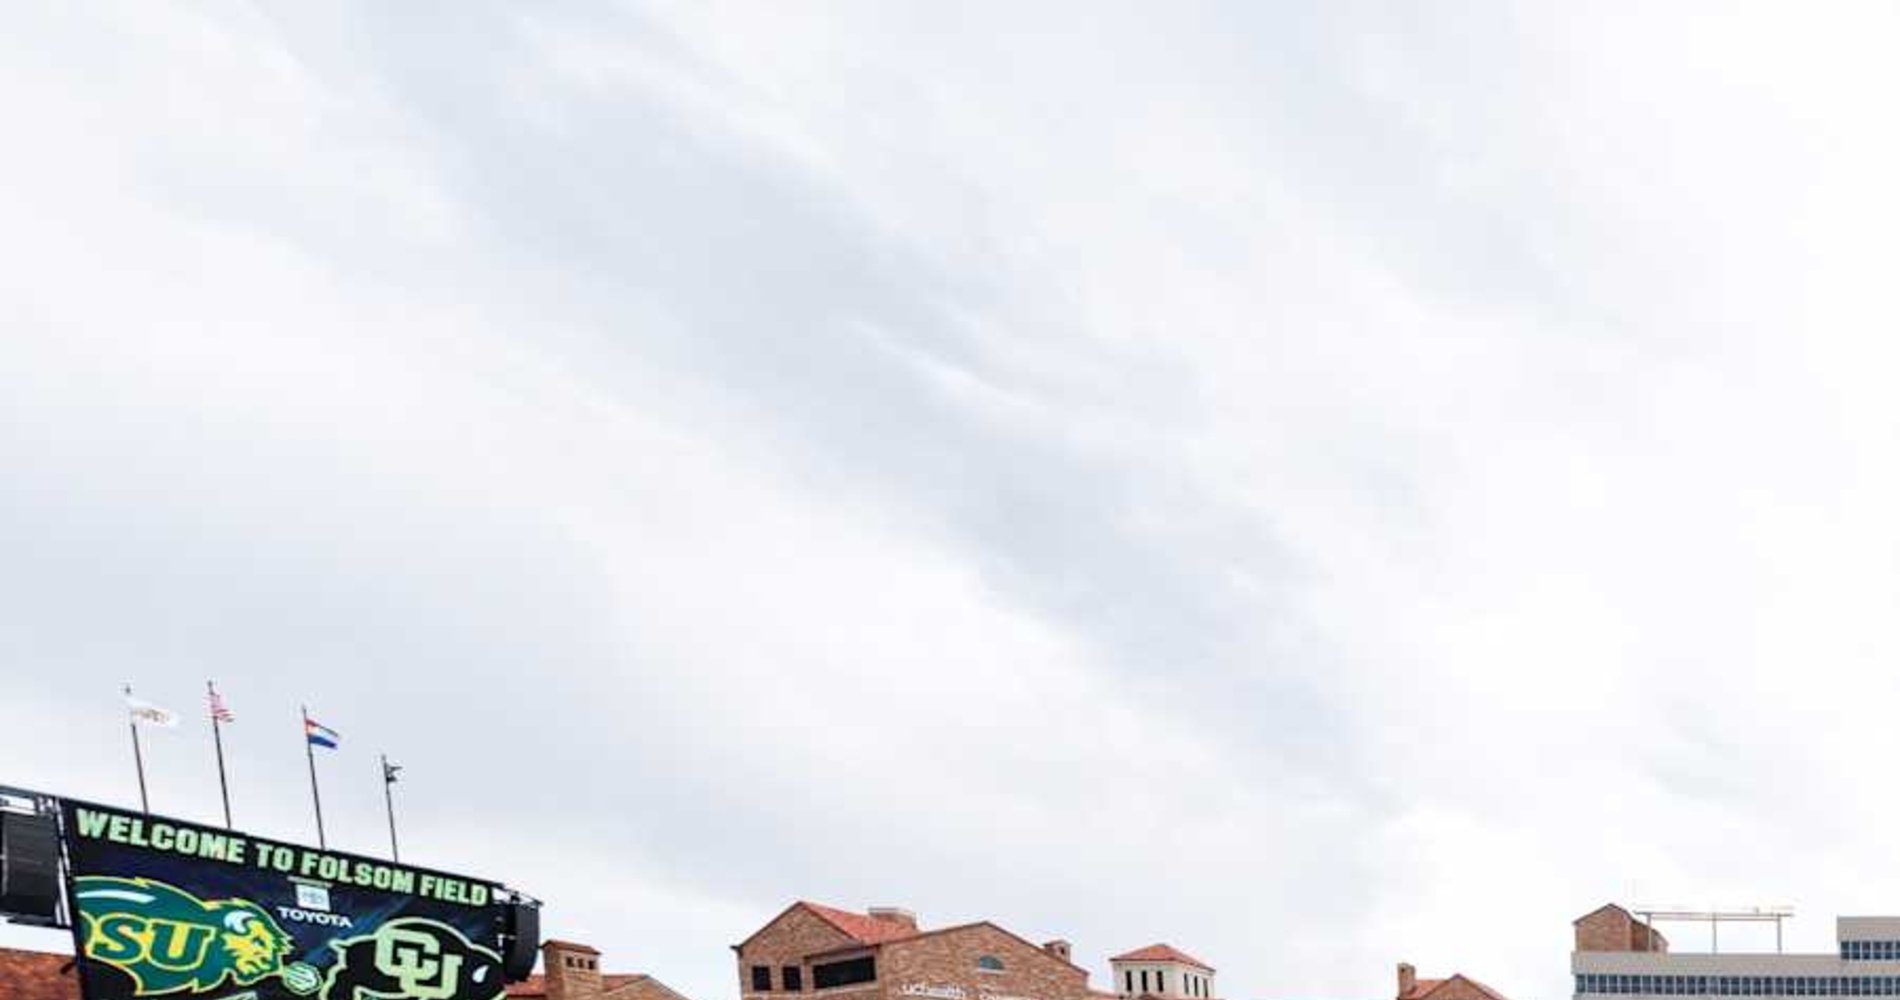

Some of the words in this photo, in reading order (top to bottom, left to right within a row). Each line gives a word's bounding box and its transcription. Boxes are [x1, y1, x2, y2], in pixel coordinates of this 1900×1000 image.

[76, 808, 246, 864] WELCOME
[256, 843, 294, 872] TO
[301, 852, 414, 894] FOLSOM
[420, 875, 488, 907] FIELD
[277, 906, 353, 928] TOYOTA
